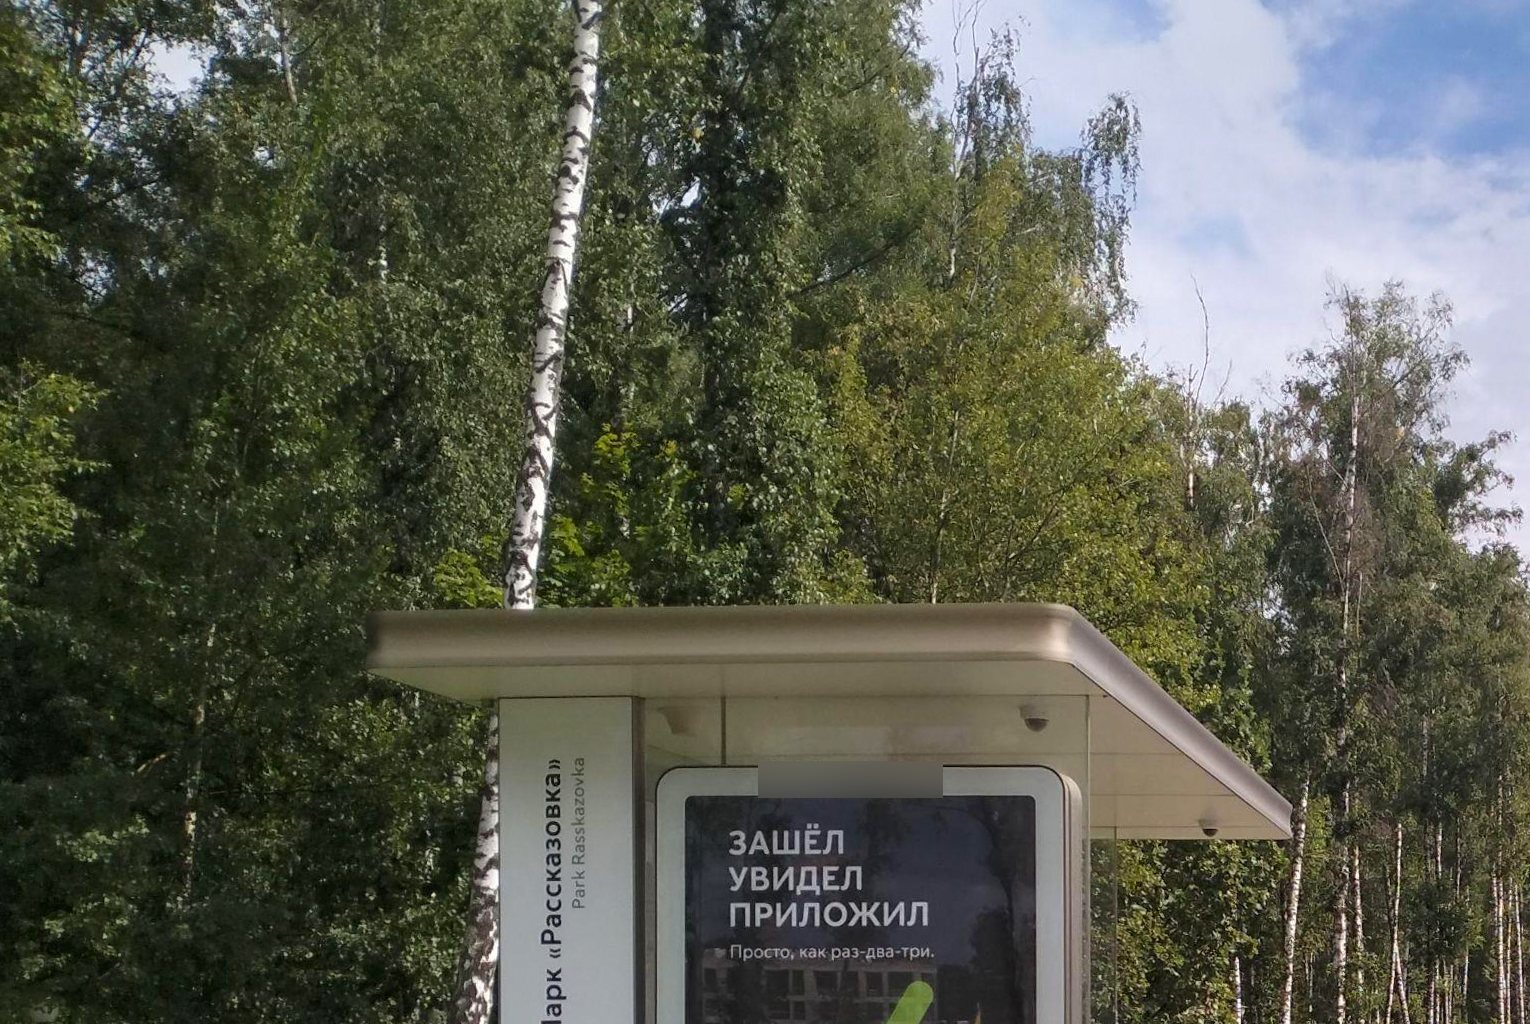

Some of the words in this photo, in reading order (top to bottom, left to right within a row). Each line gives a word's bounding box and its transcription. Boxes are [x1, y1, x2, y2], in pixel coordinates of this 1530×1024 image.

[571, 757, 586, 866] Rasskazovka
[728, 823, 844, 855] ЗАШЁЛ
[541, 758, 562, 962] «Рассказовка»
[572, 870, 586, 910] Park
[728, 866, 863, 896] УВИДЕЛ
[729, 902, 929, 927] ПРИЛОЖИЛ
[730, 945, 795, 960] Просто,
[799, 947, 827, 958] как
[831, 947, 935, 961] раз-два-три.
